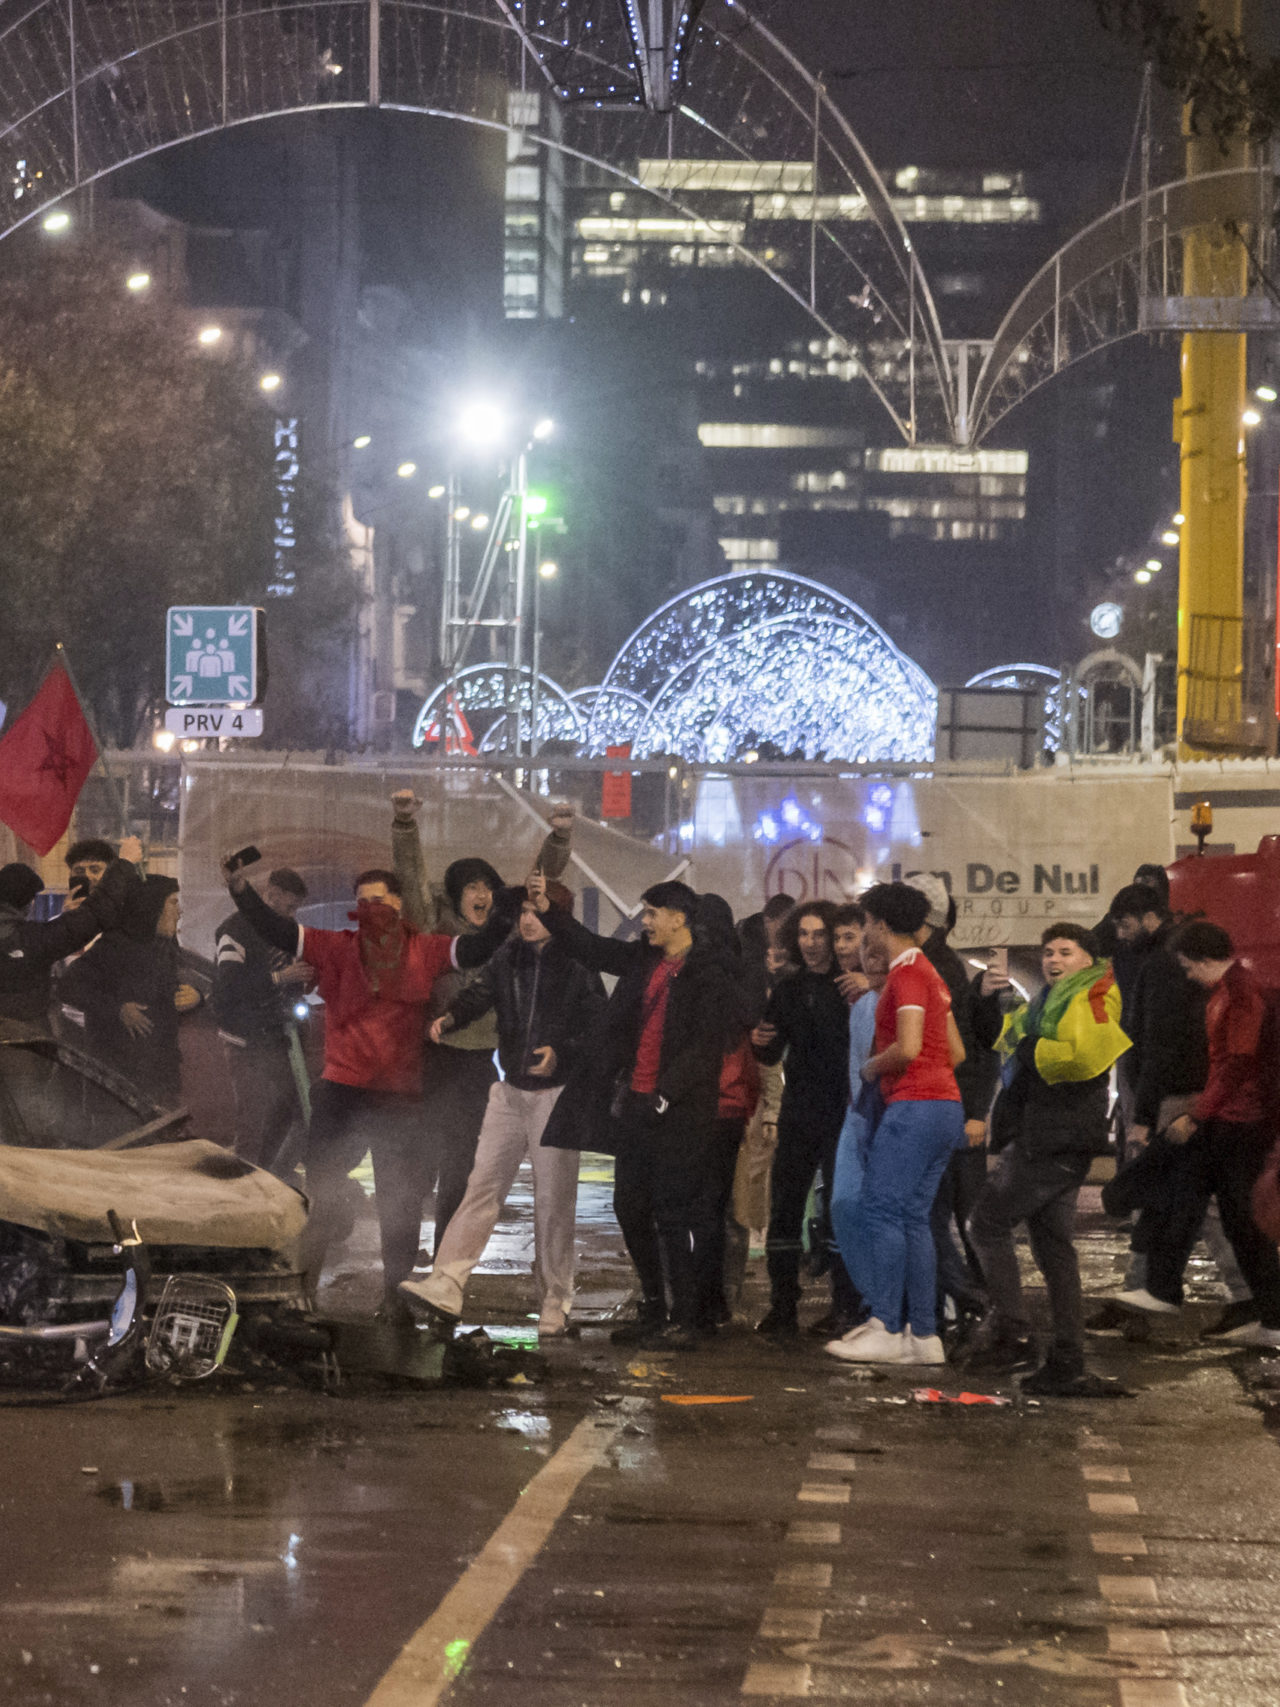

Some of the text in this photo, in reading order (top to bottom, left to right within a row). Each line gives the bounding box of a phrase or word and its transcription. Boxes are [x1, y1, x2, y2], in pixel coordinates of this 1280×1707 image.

[183, 714, 244, 732] PRV 4
[966, 863, 1020, 894] De
[1033, 863, 1099, 894] Nul
[954, 899, 1056, 915] ROUP
